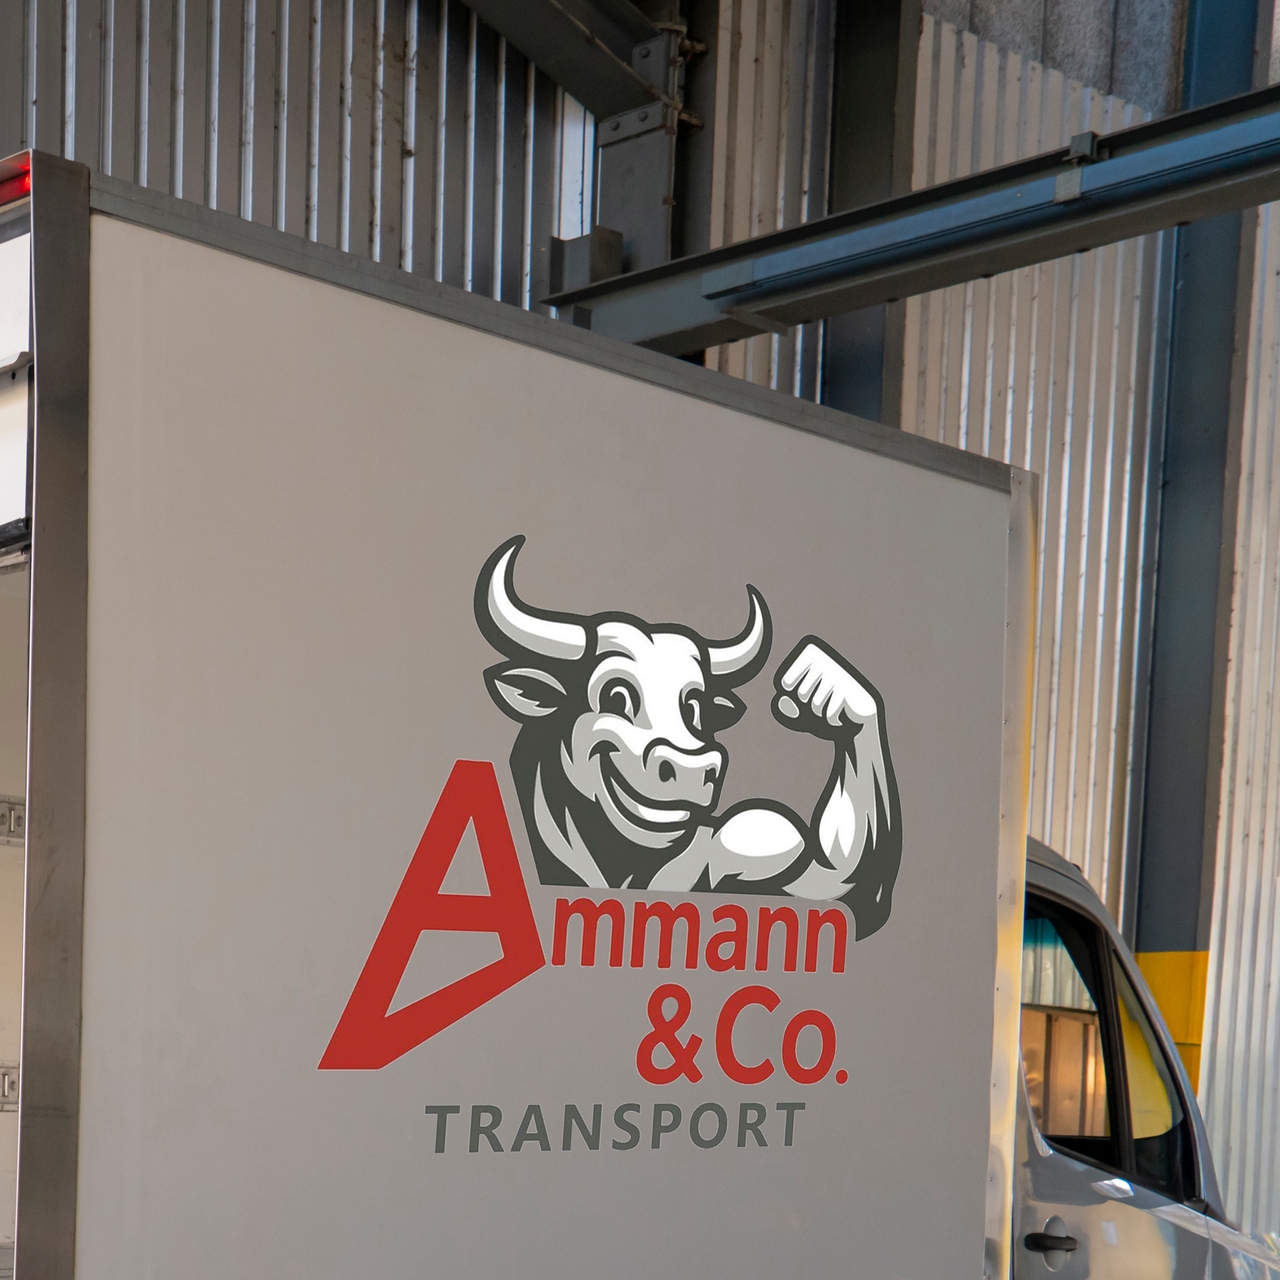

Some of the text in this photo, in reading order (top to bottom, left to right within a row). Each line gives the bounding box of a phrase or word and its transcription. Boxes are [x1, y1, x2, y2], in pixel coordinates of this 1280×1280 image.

[317, 759, 848, 1071] Ammann
[635, 983, 849, 1086] &Co.
[424, 1102, 807, 1154] TRANSPORT
